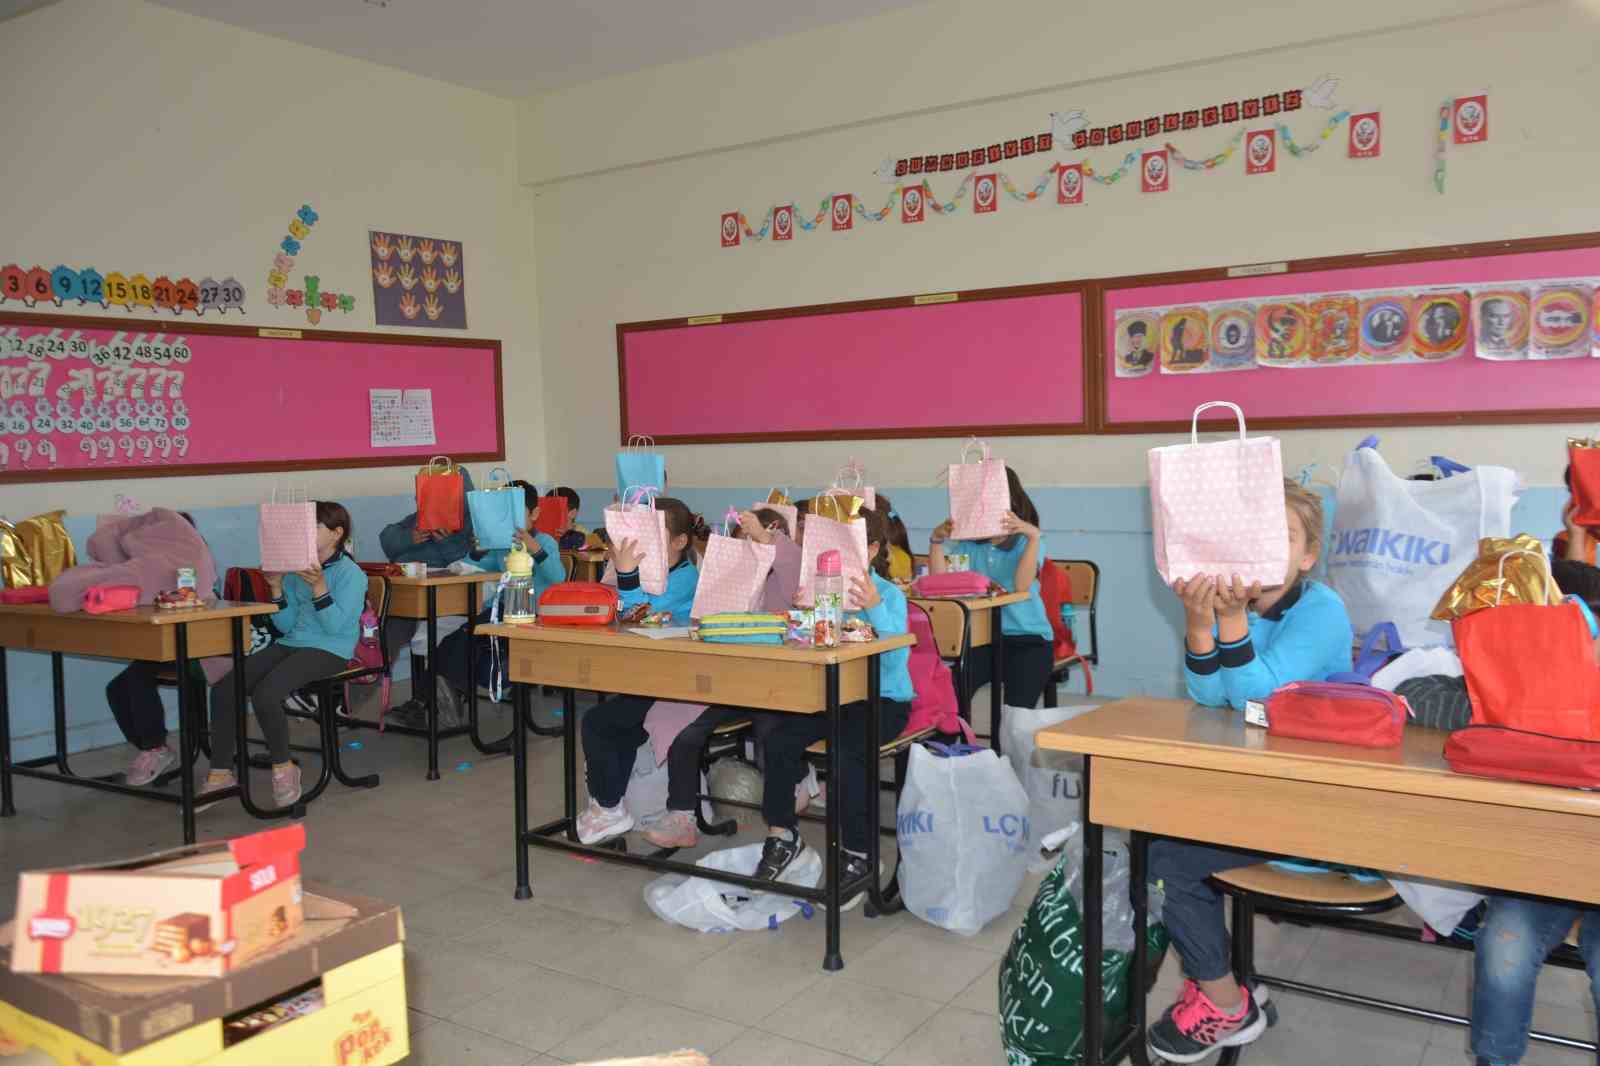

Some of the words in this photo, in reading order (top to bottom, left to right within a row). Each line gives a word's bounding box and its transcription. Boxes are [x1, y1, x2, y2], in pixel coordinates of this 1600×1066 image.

[8, 275, 19, 293] 3
[36, 276, 48, 294] 6
[59, 276, 71, 293] 9
[81, 280, 102, 296] 12
[107, 282, 127, 298] 15
[131, 285, 151, 300] 18
[154, 287, 170, 302] 21
[176, 288, 198, 304] 24
[201, 287, 218, 303] 27
[223, 287, 242, 302] 30
[47, 339, 64, 352] 24
[71, 340, 87, 352] 30
[113, 347, 131, 360] 42
[136, 346, 152, 358] 48
[154, 347, 171, 360] 54
[174, 347, 188, 358] 60
